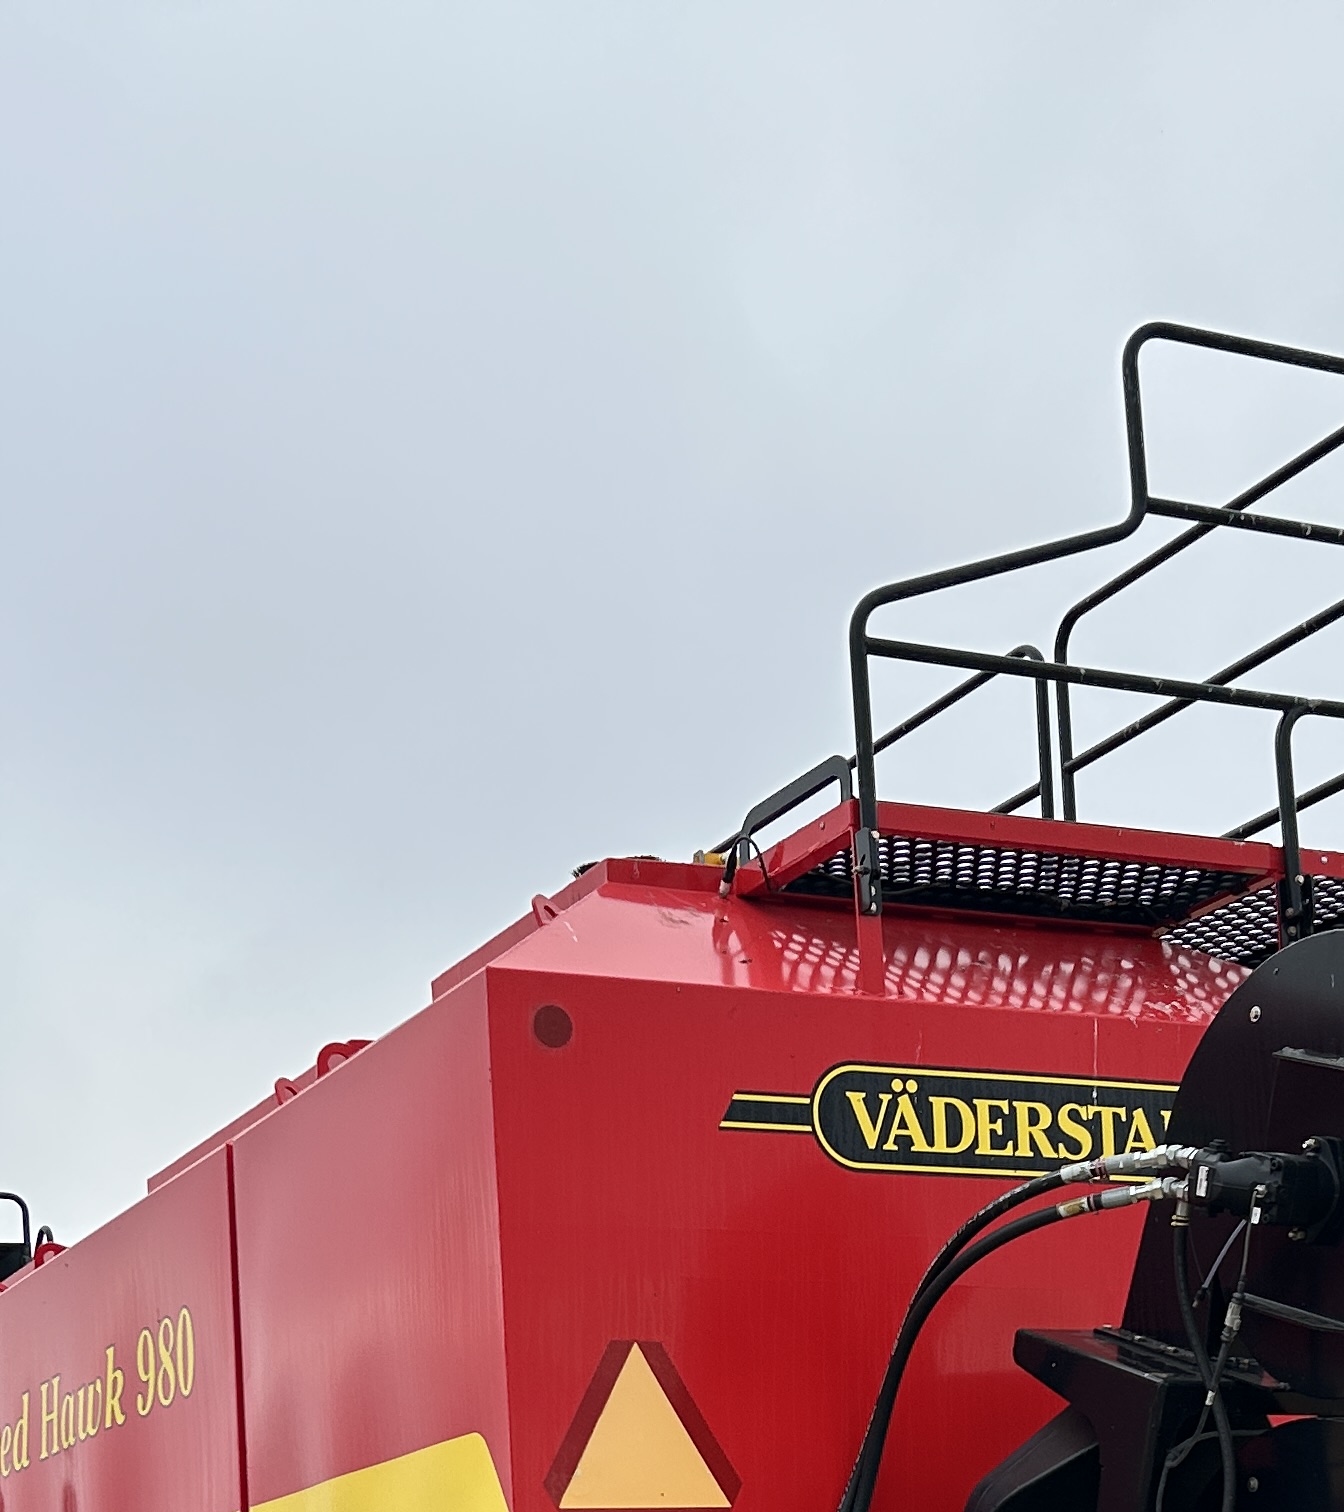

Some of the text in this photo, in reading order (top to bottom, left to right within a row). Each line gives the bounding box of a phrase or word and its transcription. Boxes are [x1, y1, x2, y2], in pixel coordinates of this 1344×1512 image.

[845, 1078, 1172, 1160] VÄDERSTA
[39, 1343, 126, 1461] Hawk
[136, 1305, 195, 1417] 980
